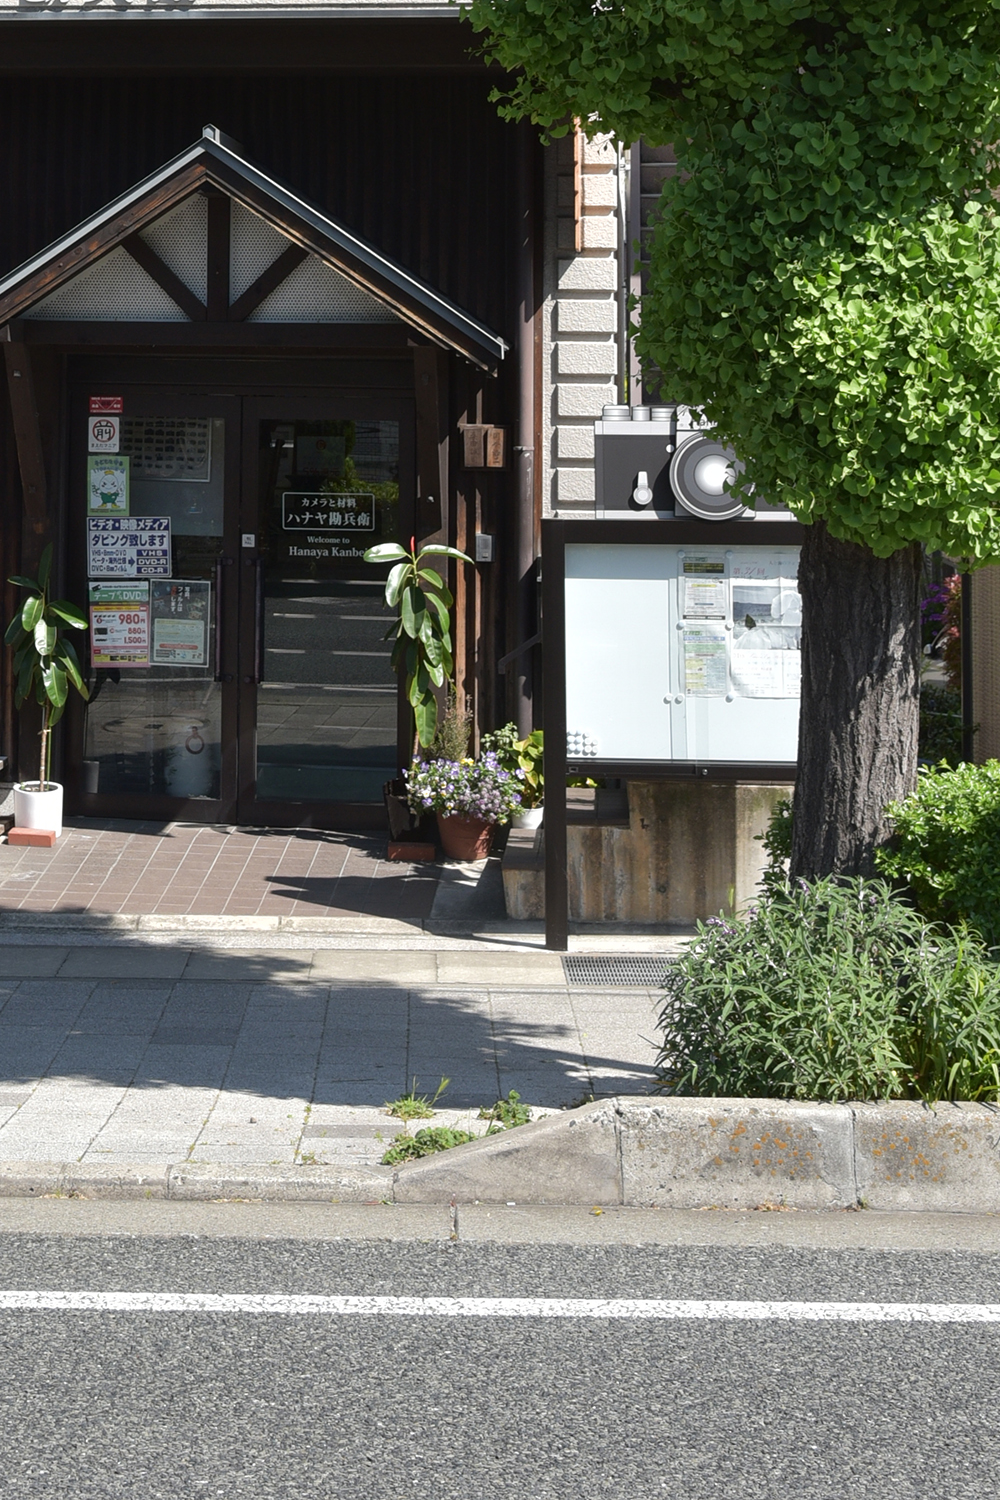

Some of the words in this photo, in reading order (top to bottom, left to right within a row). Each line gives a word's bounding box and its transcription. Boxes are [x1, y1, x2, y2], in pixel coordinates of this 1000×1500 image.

[301, 498, 356, 508] カメラと材料
[286, 511, 371, 526] ハナヤ勘兵衛
[92, 534, 167, 547] ダビング致します
[289, 546, 329, 559] Hanaya
[331, 547, 368, 557] Kanbe
